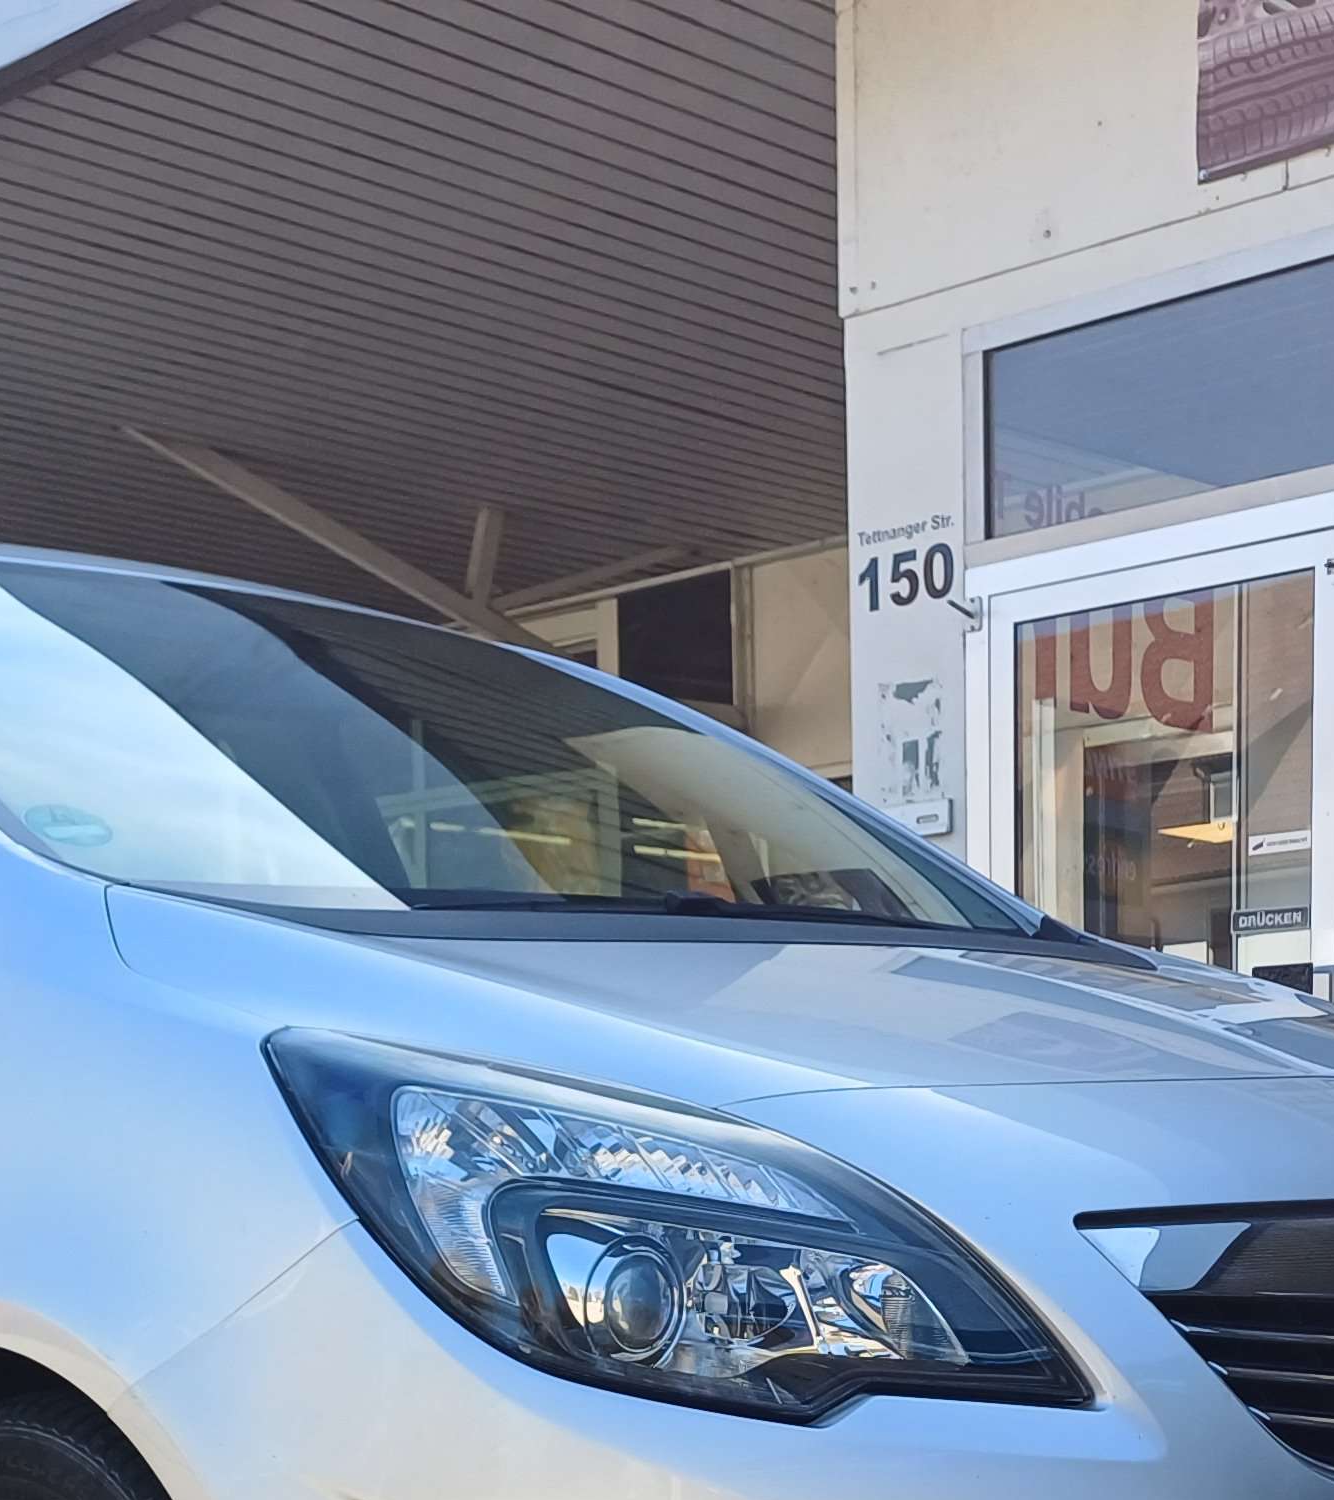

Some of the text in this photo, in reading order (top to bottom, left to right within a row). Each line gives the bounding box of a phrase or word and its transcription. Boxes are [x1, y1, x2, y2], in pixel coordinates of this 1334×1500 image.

[858, 515, 954, 546] Tettnanger Str.
[859, 543, 954, 612] 150
[1238, 910, 1302, 929] DRÜCKEN
